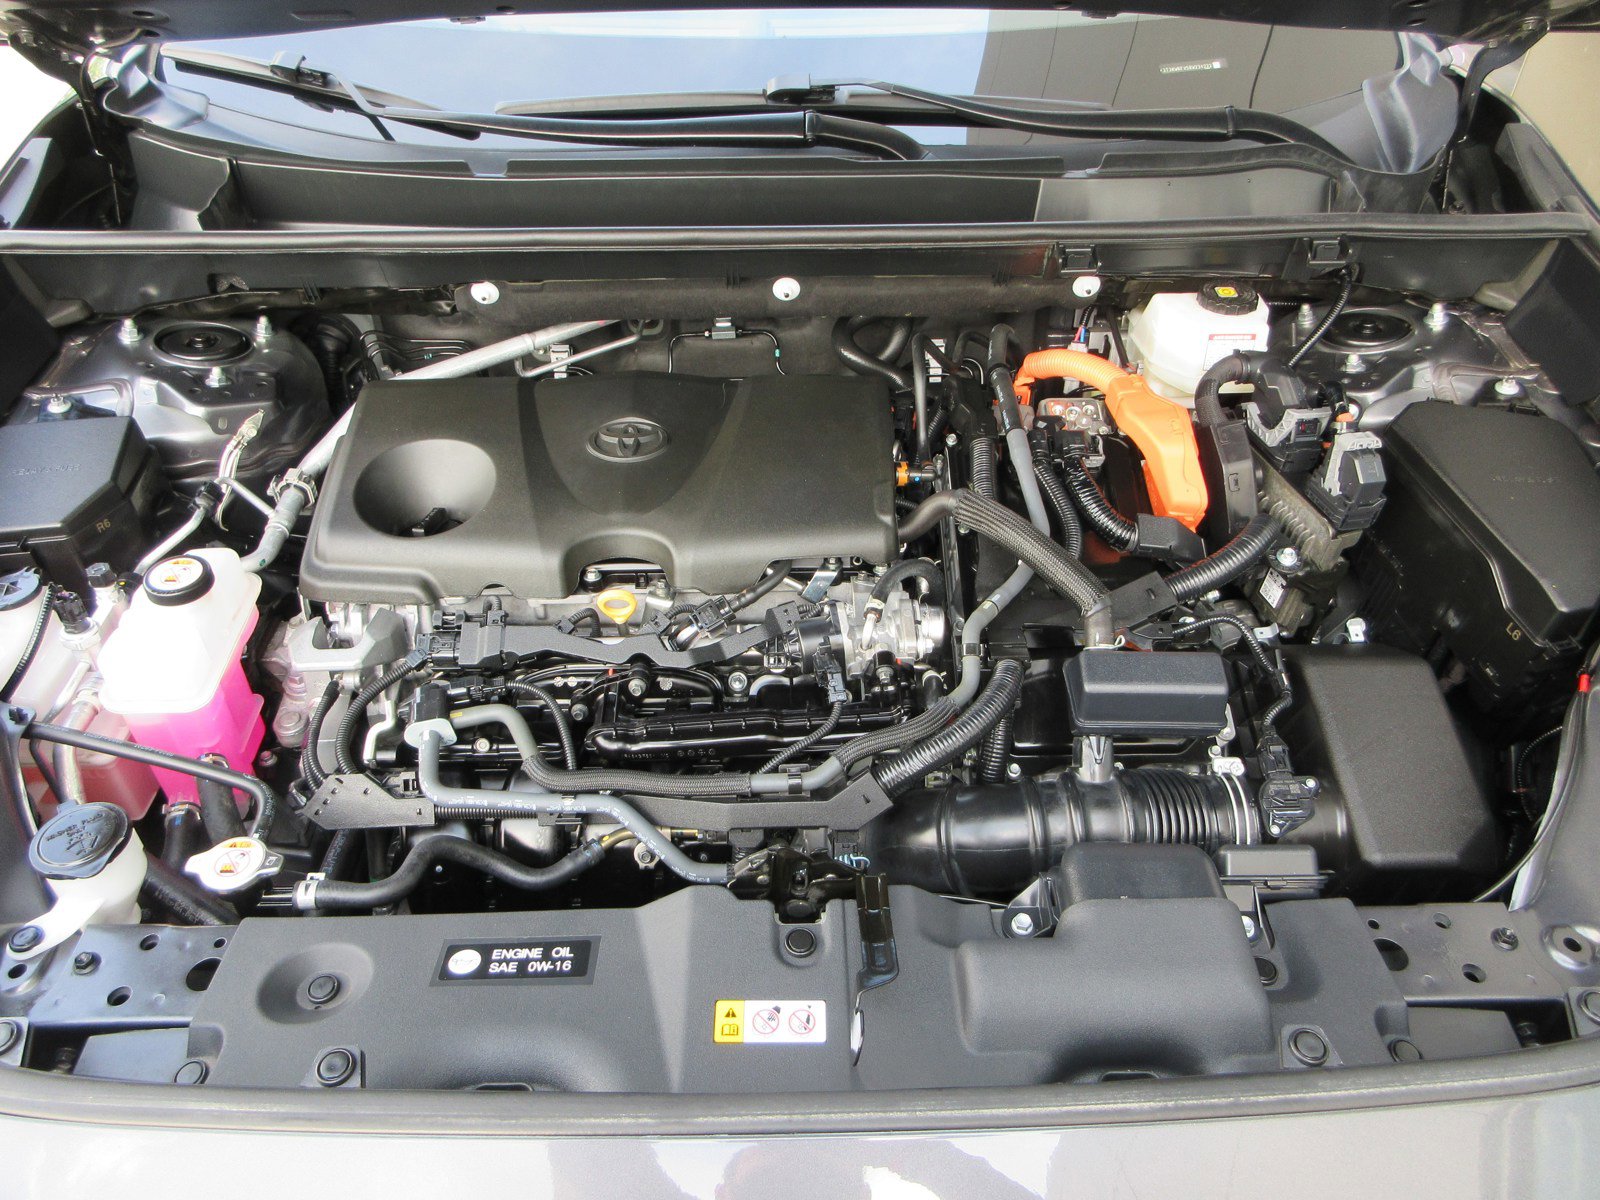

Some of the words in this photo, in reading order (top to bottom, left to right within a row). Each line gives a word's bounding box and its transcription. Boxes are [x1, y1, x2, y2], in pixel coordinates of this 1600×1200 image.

[96, 518, 111, 533] R6
[1506, 622, 1521, 641] L6
[492, 948, 543, 960] ENGINE
[552, 947, 574, 958] OIL
[489, 962, 519, 973] SAE
[527, 961, 572, 972] 0W-16
